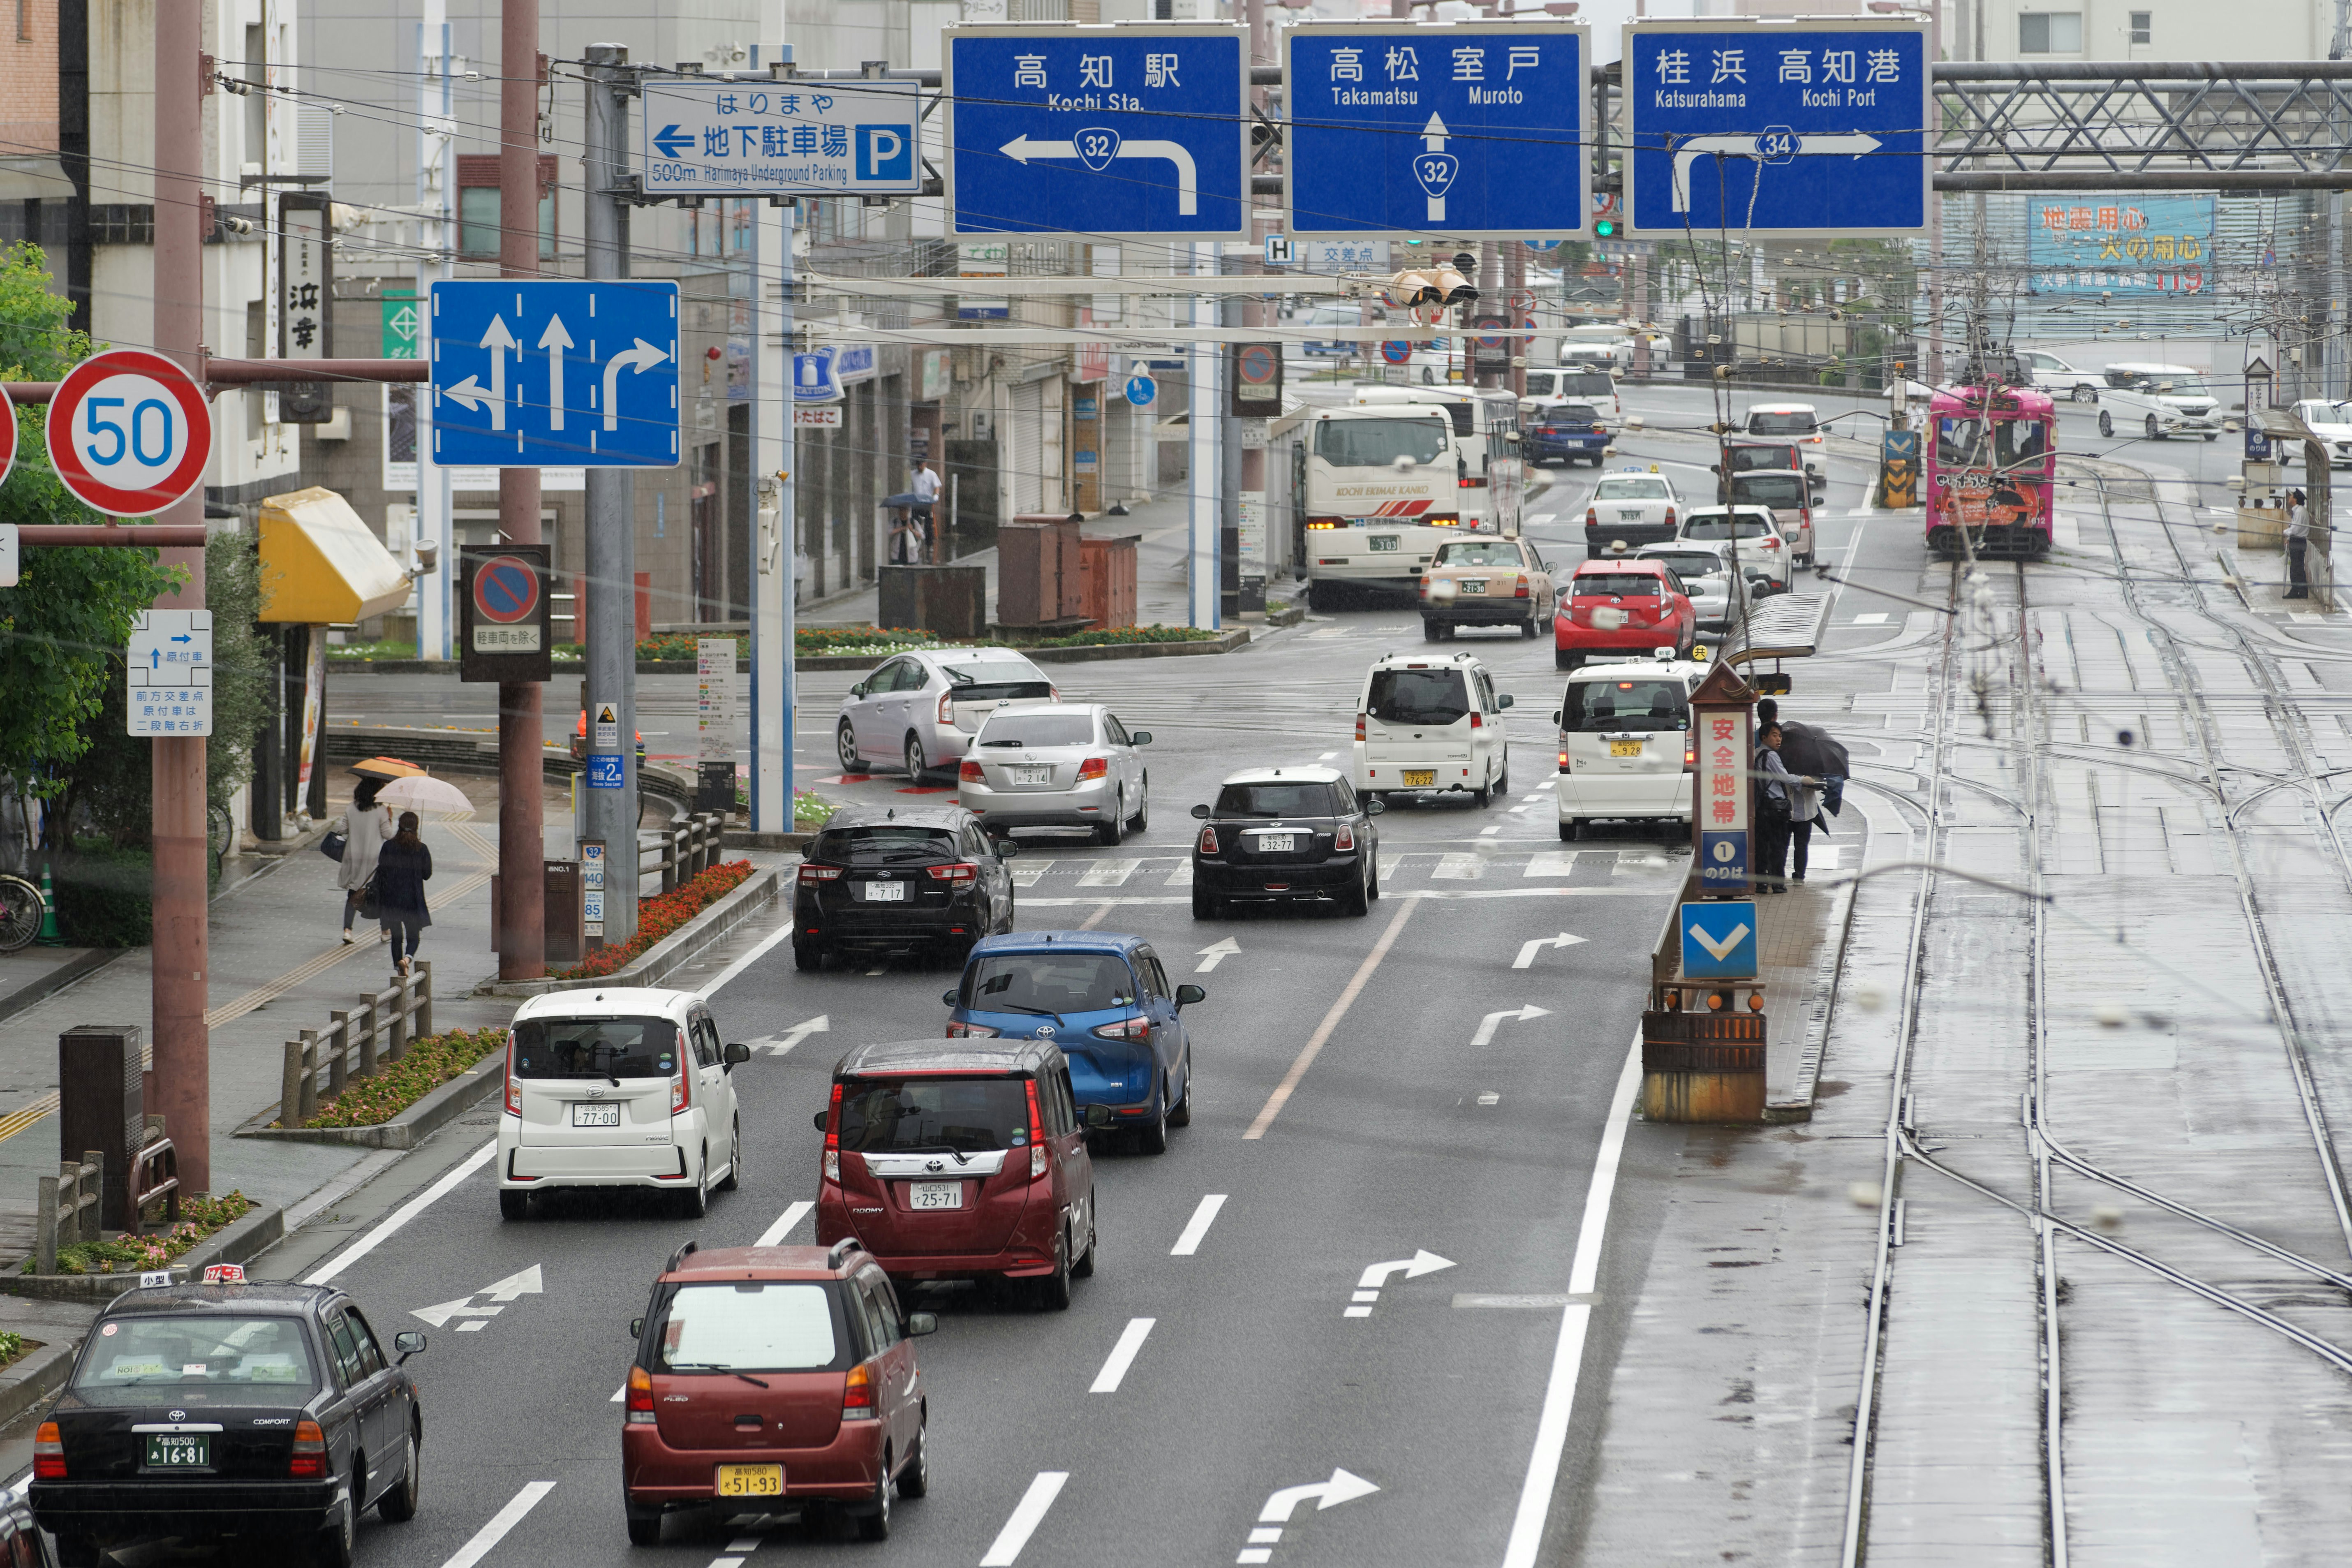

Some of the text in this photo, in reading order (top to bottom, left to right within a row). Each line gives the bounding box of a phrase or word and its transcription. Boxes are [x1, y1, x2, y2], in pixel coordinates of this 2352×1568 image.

[1014, 53, 1181, 88] 高知駅
[1330, 46, 1419, 82] 高松
[1452, 46, 1540, 81] 室戸
[1656, 49, 1746, 84] 桂浜
[1778, 48, 1900, 83] 高知港
[717, 93, 833, 115] はりまや
[1049, 94, 1144, 112] Kochi Sta.
[1331, 87, 1418, 105] Takamatsu
[1469, 86, 1523, 104] Muroto
[1656, 90, 1746, 108] Katsurahama
[1803, 88, 1876, 106] Kochi Port
[703, 125, 848, 158] 地下駐車場
[1085, 136, 1109, 157] 32
[1766, 135, 1790, 155] 34
[870, 130, 902, 175] P
[652, 164, 847, 185] 500m Harimaya Underground Parking
[1424, 162, 1448, 183] 32
[2042, 206, 2148, 232] 地震用心
[1273, 241, 1288, 259] H
[1325, 247, 1373, 261] 交差点
[2099, 234, 2201, 261] 火の用心
[290, 282, 319, 349] 浜幸
[87, 397, 172, 467] 50
[1337, 485, 1429, 496] KOCHI EKIMAE KANKO
[477, 631, 537, 645] 軽車両を除く
[167, 652, 203, 661] 原付車
[1695, 648, 1705, 657] 共
[136, 691, 204, 701] 前方交差点
[144, 706, 196, 716] 原付車は
[137, 721, 203, 731] 二段階右折
[1713, 719, 1735, 824] 安全地帯
[589, 848, 598, 856] 32
[1267, 841, 1292, 850] 32-77
[585, 873, 603, 883] 140
[1705, 867, 1743, 880] のりば
[585, 904, 600, 915] 85
[583, 1112, 617, 1124] 77-00
[922, 1193, 957, 1206] 25-71
[145, 1275, 164, 1285] 小型
[206, 1269, 240, 1279] けんこう
[162, 1437, 195, 1446] 高知500
[151, 1447, 203, 1464] あ 16-81
[733, 1478, 777, 1492] 51-93
